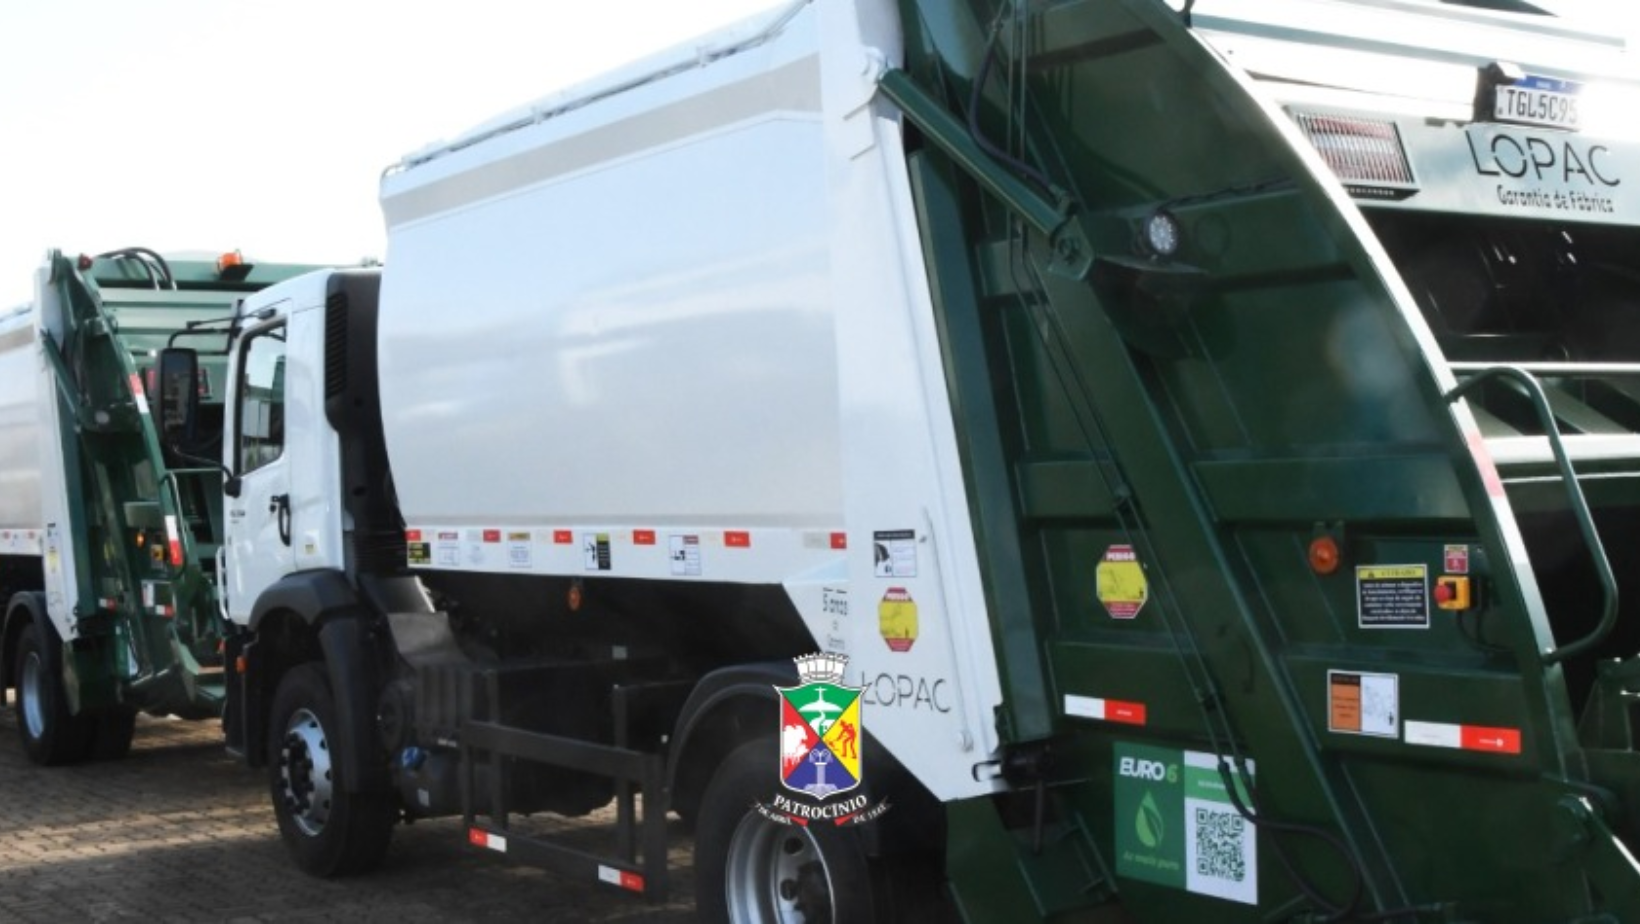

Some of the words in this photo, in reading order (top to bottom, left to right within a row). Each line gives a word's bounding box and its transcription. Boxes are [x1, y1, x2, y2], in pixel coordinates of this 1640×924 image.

[1506, 89, 1578, 124] TGL5C95
[1465, 130, 1620, 186] LOPAC
[1497, 184, 1552, 209] Garantia
[1553, 190, 1569, 210] de
[861, 671, 951, 714] LOPAC
[1119, 756, 1166, 781] EURO
[1166, 764, 1179, 783] 6
